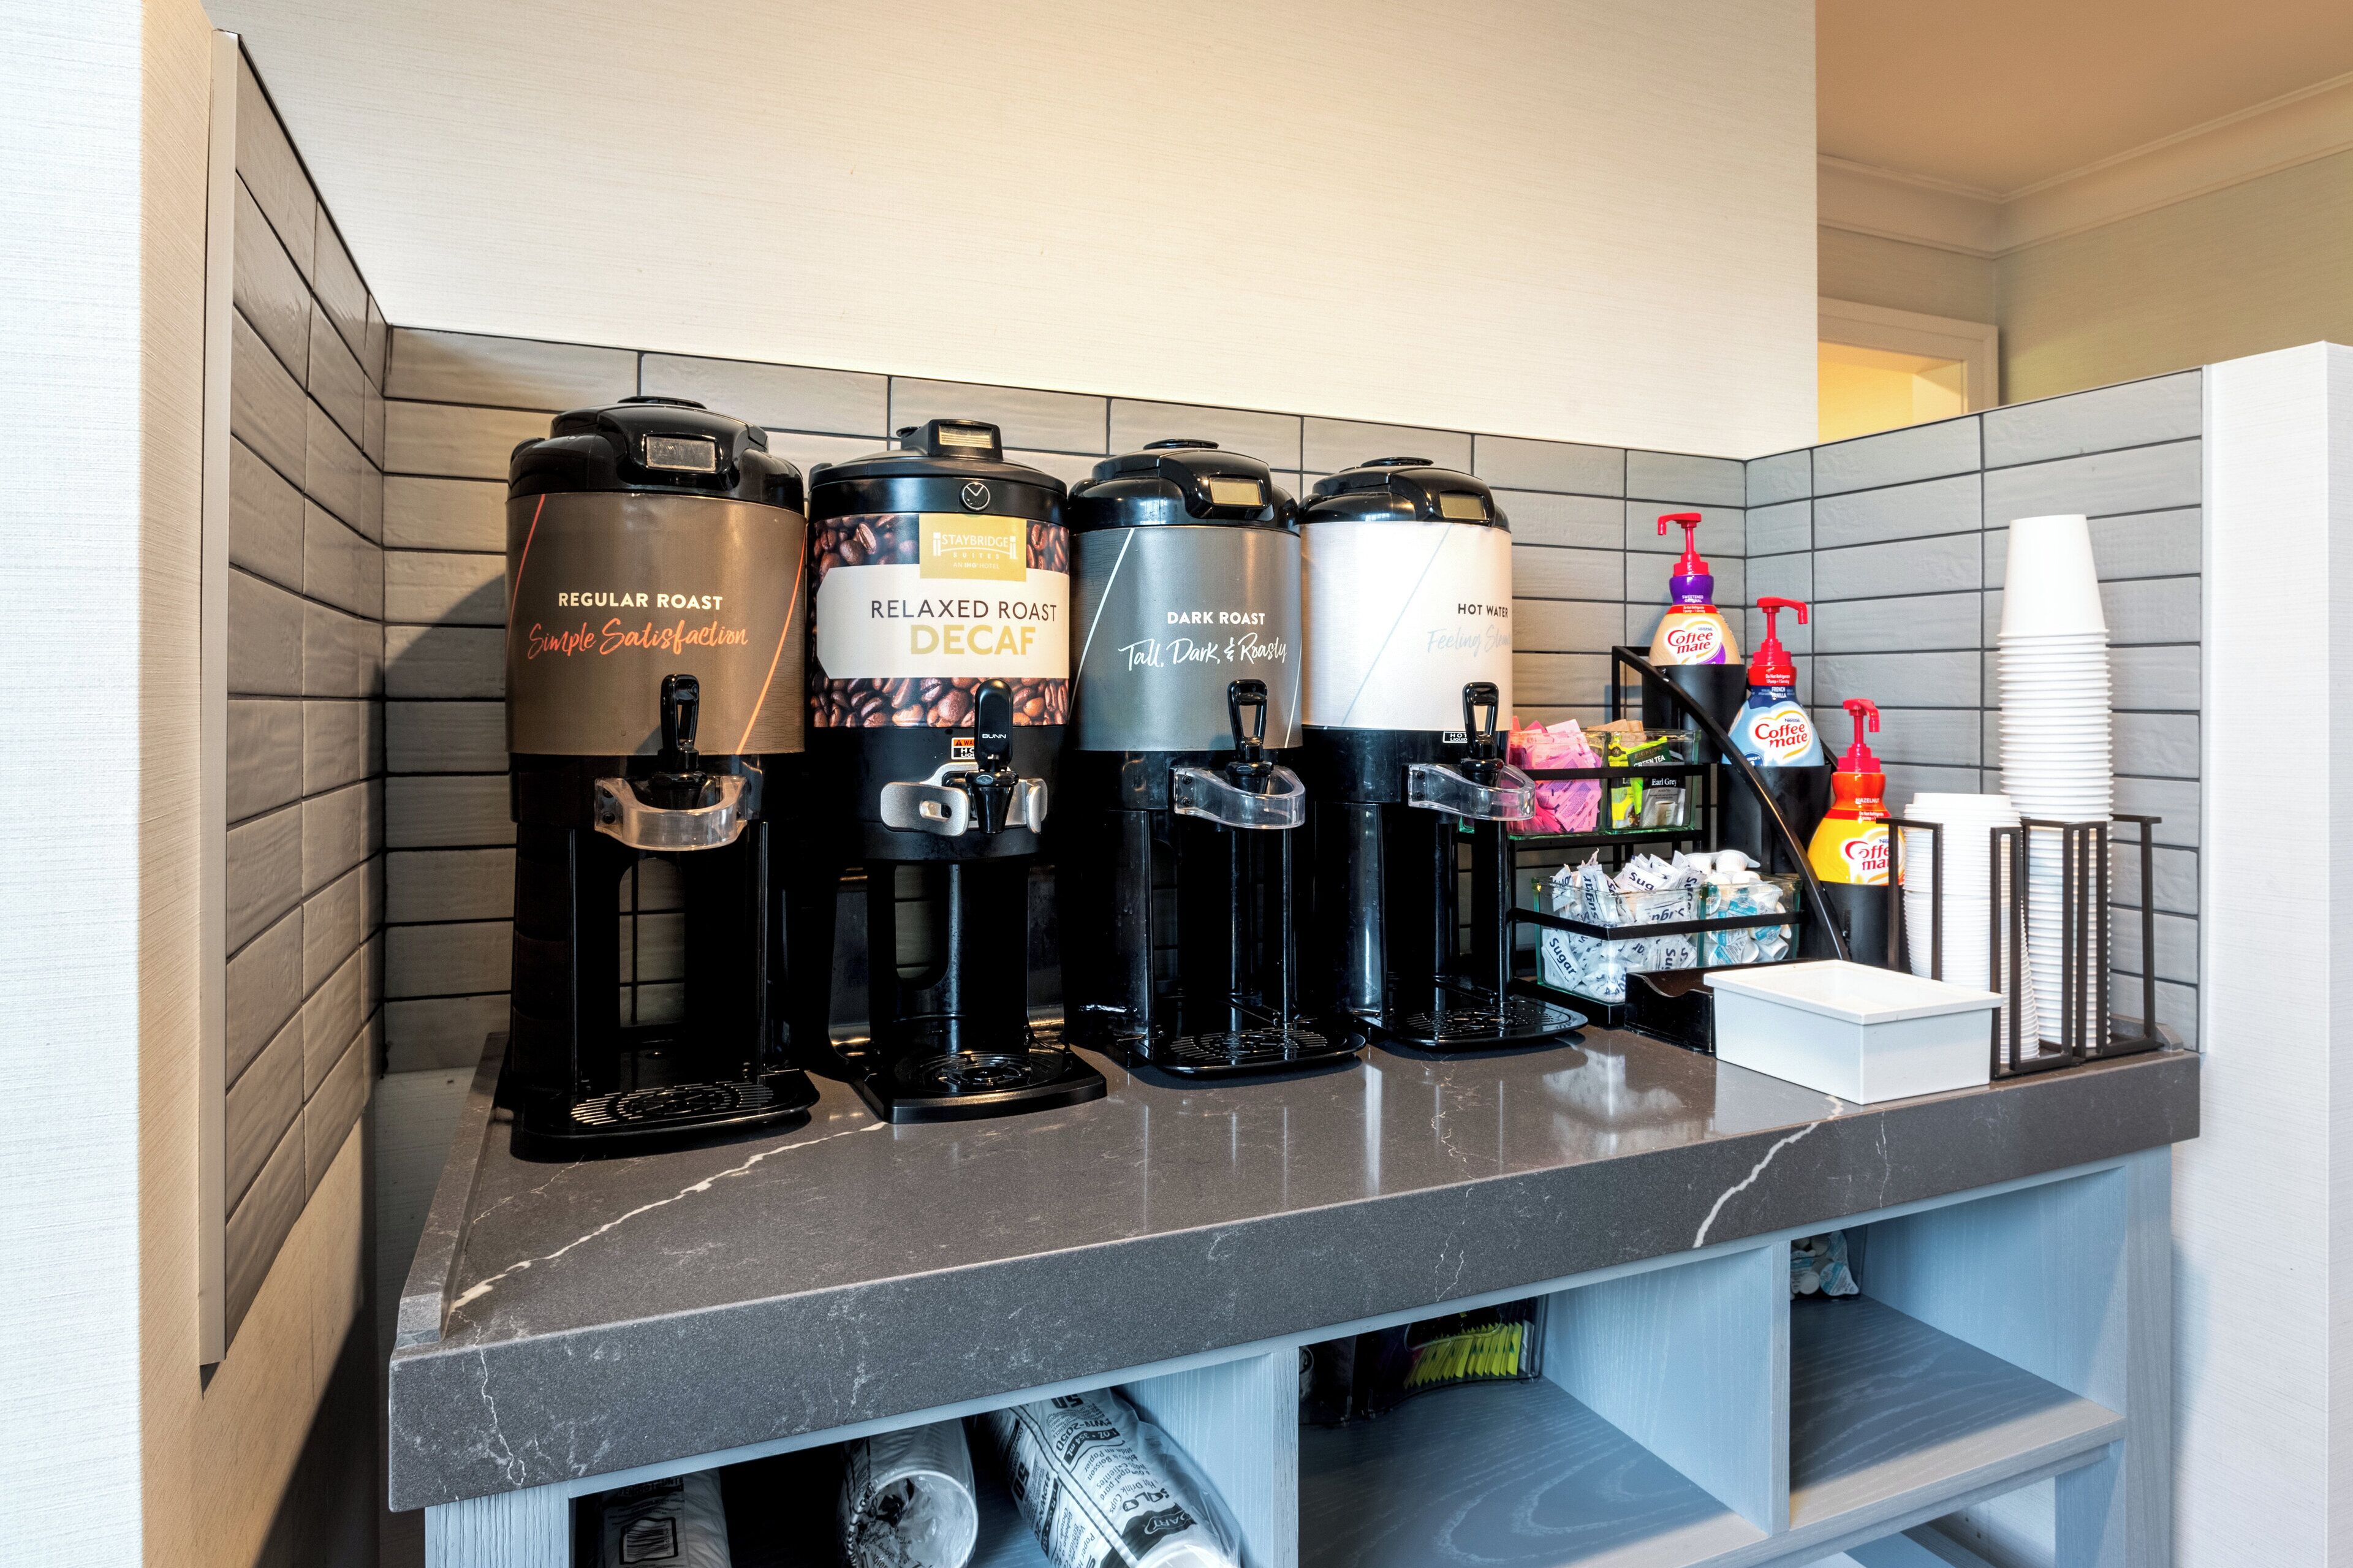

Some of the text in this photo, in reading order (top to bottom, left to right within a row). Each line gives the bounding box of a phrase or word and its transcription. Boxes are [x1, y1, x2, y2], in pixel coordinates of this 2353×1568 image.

[941, 534, 1009, 548] STAYBRIDGE
[558, 592, 723, 610] REGULAR ROAST
[871, 599, 1057, 622] RELAXED ROAST
[1458, 603, 1509, 618] HOT WATER
[1167, 612, 1265, 626] DARK ROAST
[527, 617, 749, 660] Simple Satisfaction
[910, 624, 1036, 656] DECAF
[1427, 626, 1482, 657] Feeling
[1667, 629, 1714, 646] Coffee
[1118, 632, 1287, 672] Tall, Dark, & Roasty
[1677, 641, 1711, 654] mate
[1754, 723, 1805, 740] Coffee
[1769, 733, 1808, 748] mate
[1654, 754, 1666, 763] TEA
[1664, 778, 1677, 787] Grey
[1844, 841, 1889, 860] Coffe
[1629, 872, 1654, 892] Sug
[1583, 876, 1599, 920] Sugar
[1549, 937, 1577, 974] Sugar
[1075, 1432, 1089, 1444] 354
[1083, 1450, 1105, 1473] Papier
[1086, 1456, 1113, 1482] Boisson
[1099, 1481, 1115, 1501] para
[1120, 1482, 1143, 1496] Drink
[1108, 1493, 1123, 1515] Cups
[1081, 1532, 1096, 1559] Paper
